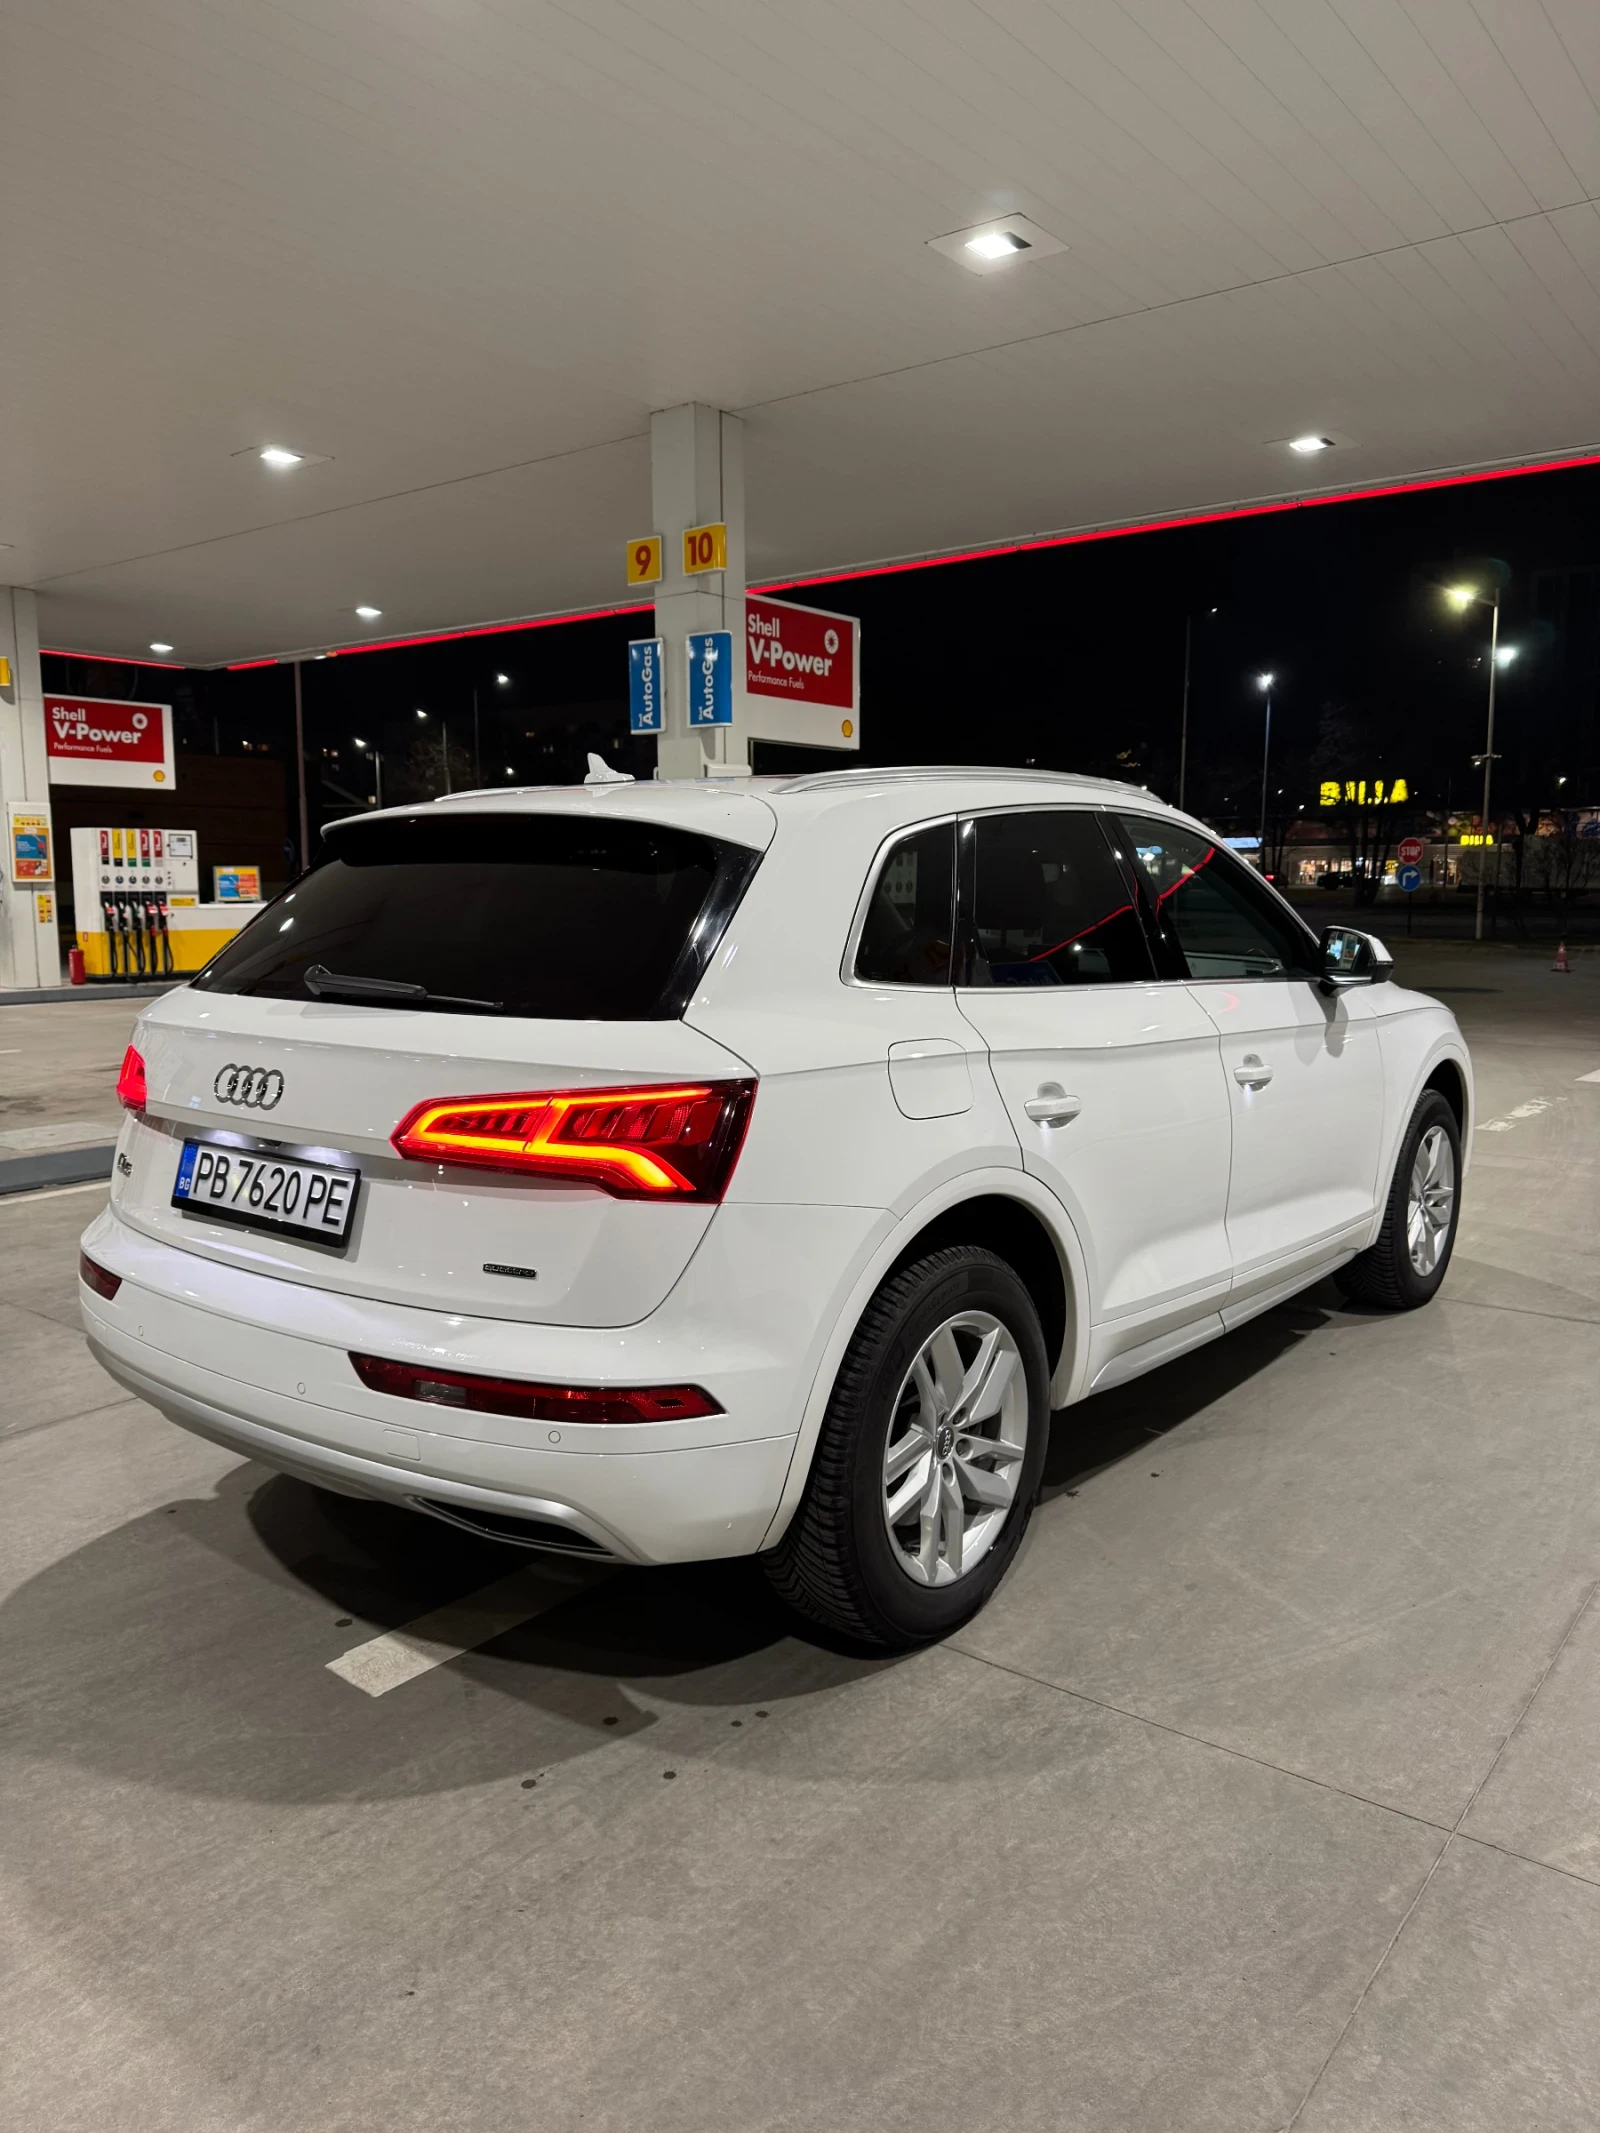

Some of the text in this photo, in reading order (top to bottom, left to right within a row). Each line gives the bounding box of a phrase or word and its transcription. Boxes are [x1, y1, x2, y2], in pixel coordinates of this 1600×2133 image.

[635, 544, 652, 577] 9
[687, 531, 713, 566] 10
[747, 612, 780, 638] Shell
[747, 635, 833, 677] V-Power
[641, 645, 654, 726] AutoGas
[701, 637, 715, 720] AutoGas
[747, 669, 805, 690] Performance Fuels
[51, 706, 86, 722] Shell
[52, 720, 143, 745] V-Power
[53, 741, 113, 754] Performance Fuels
[1400, 846, 1420, 857] STOP
[178, 1176, 191, 1191] BG
[192, 1151, 351, 1227] PB 7620 PE
